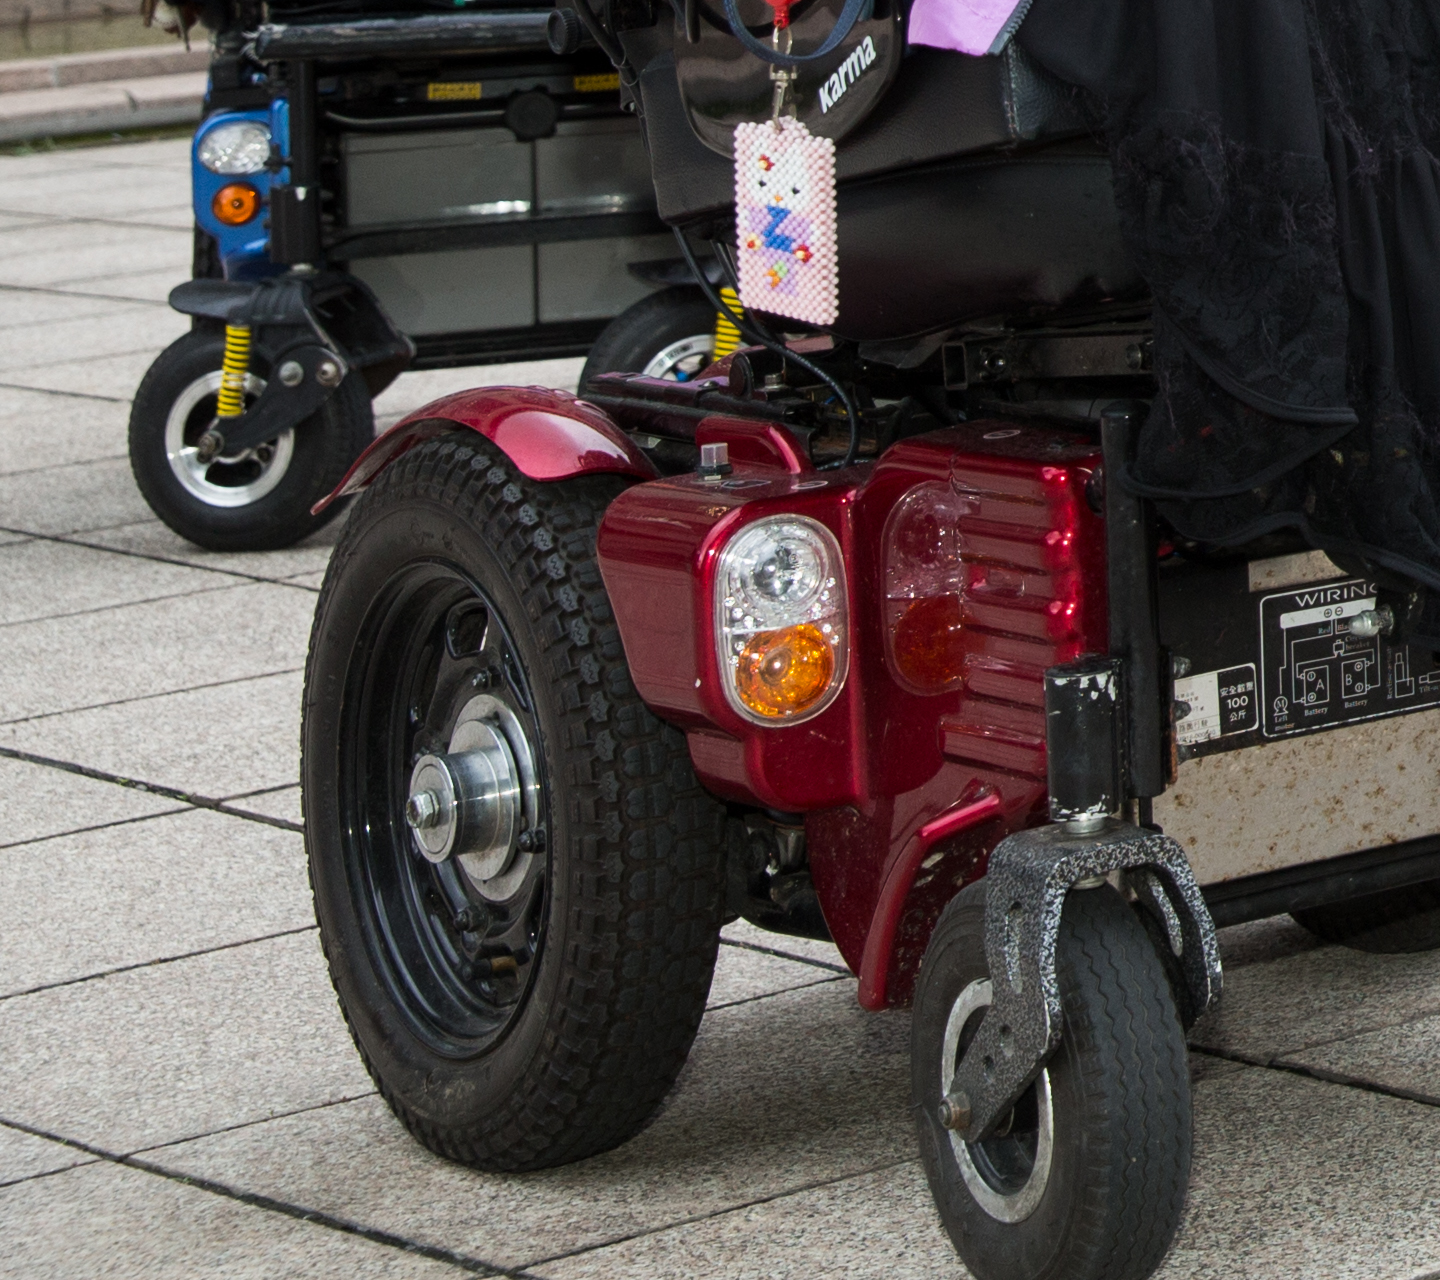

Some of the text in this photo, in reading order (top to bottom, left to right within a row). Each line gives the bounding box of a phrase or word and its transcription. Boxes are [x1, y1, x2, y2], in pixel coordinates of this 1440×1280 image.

[1316, 678, 1325, 691] A
[1345, 673, 1353, 686] B
[1227, 695, 1249, 709] 100
[1344, 698, 1368, 709] Battery
[1229, 709, 1247, 722] 公斤
[1304, 706, 1329, 717] Battery
